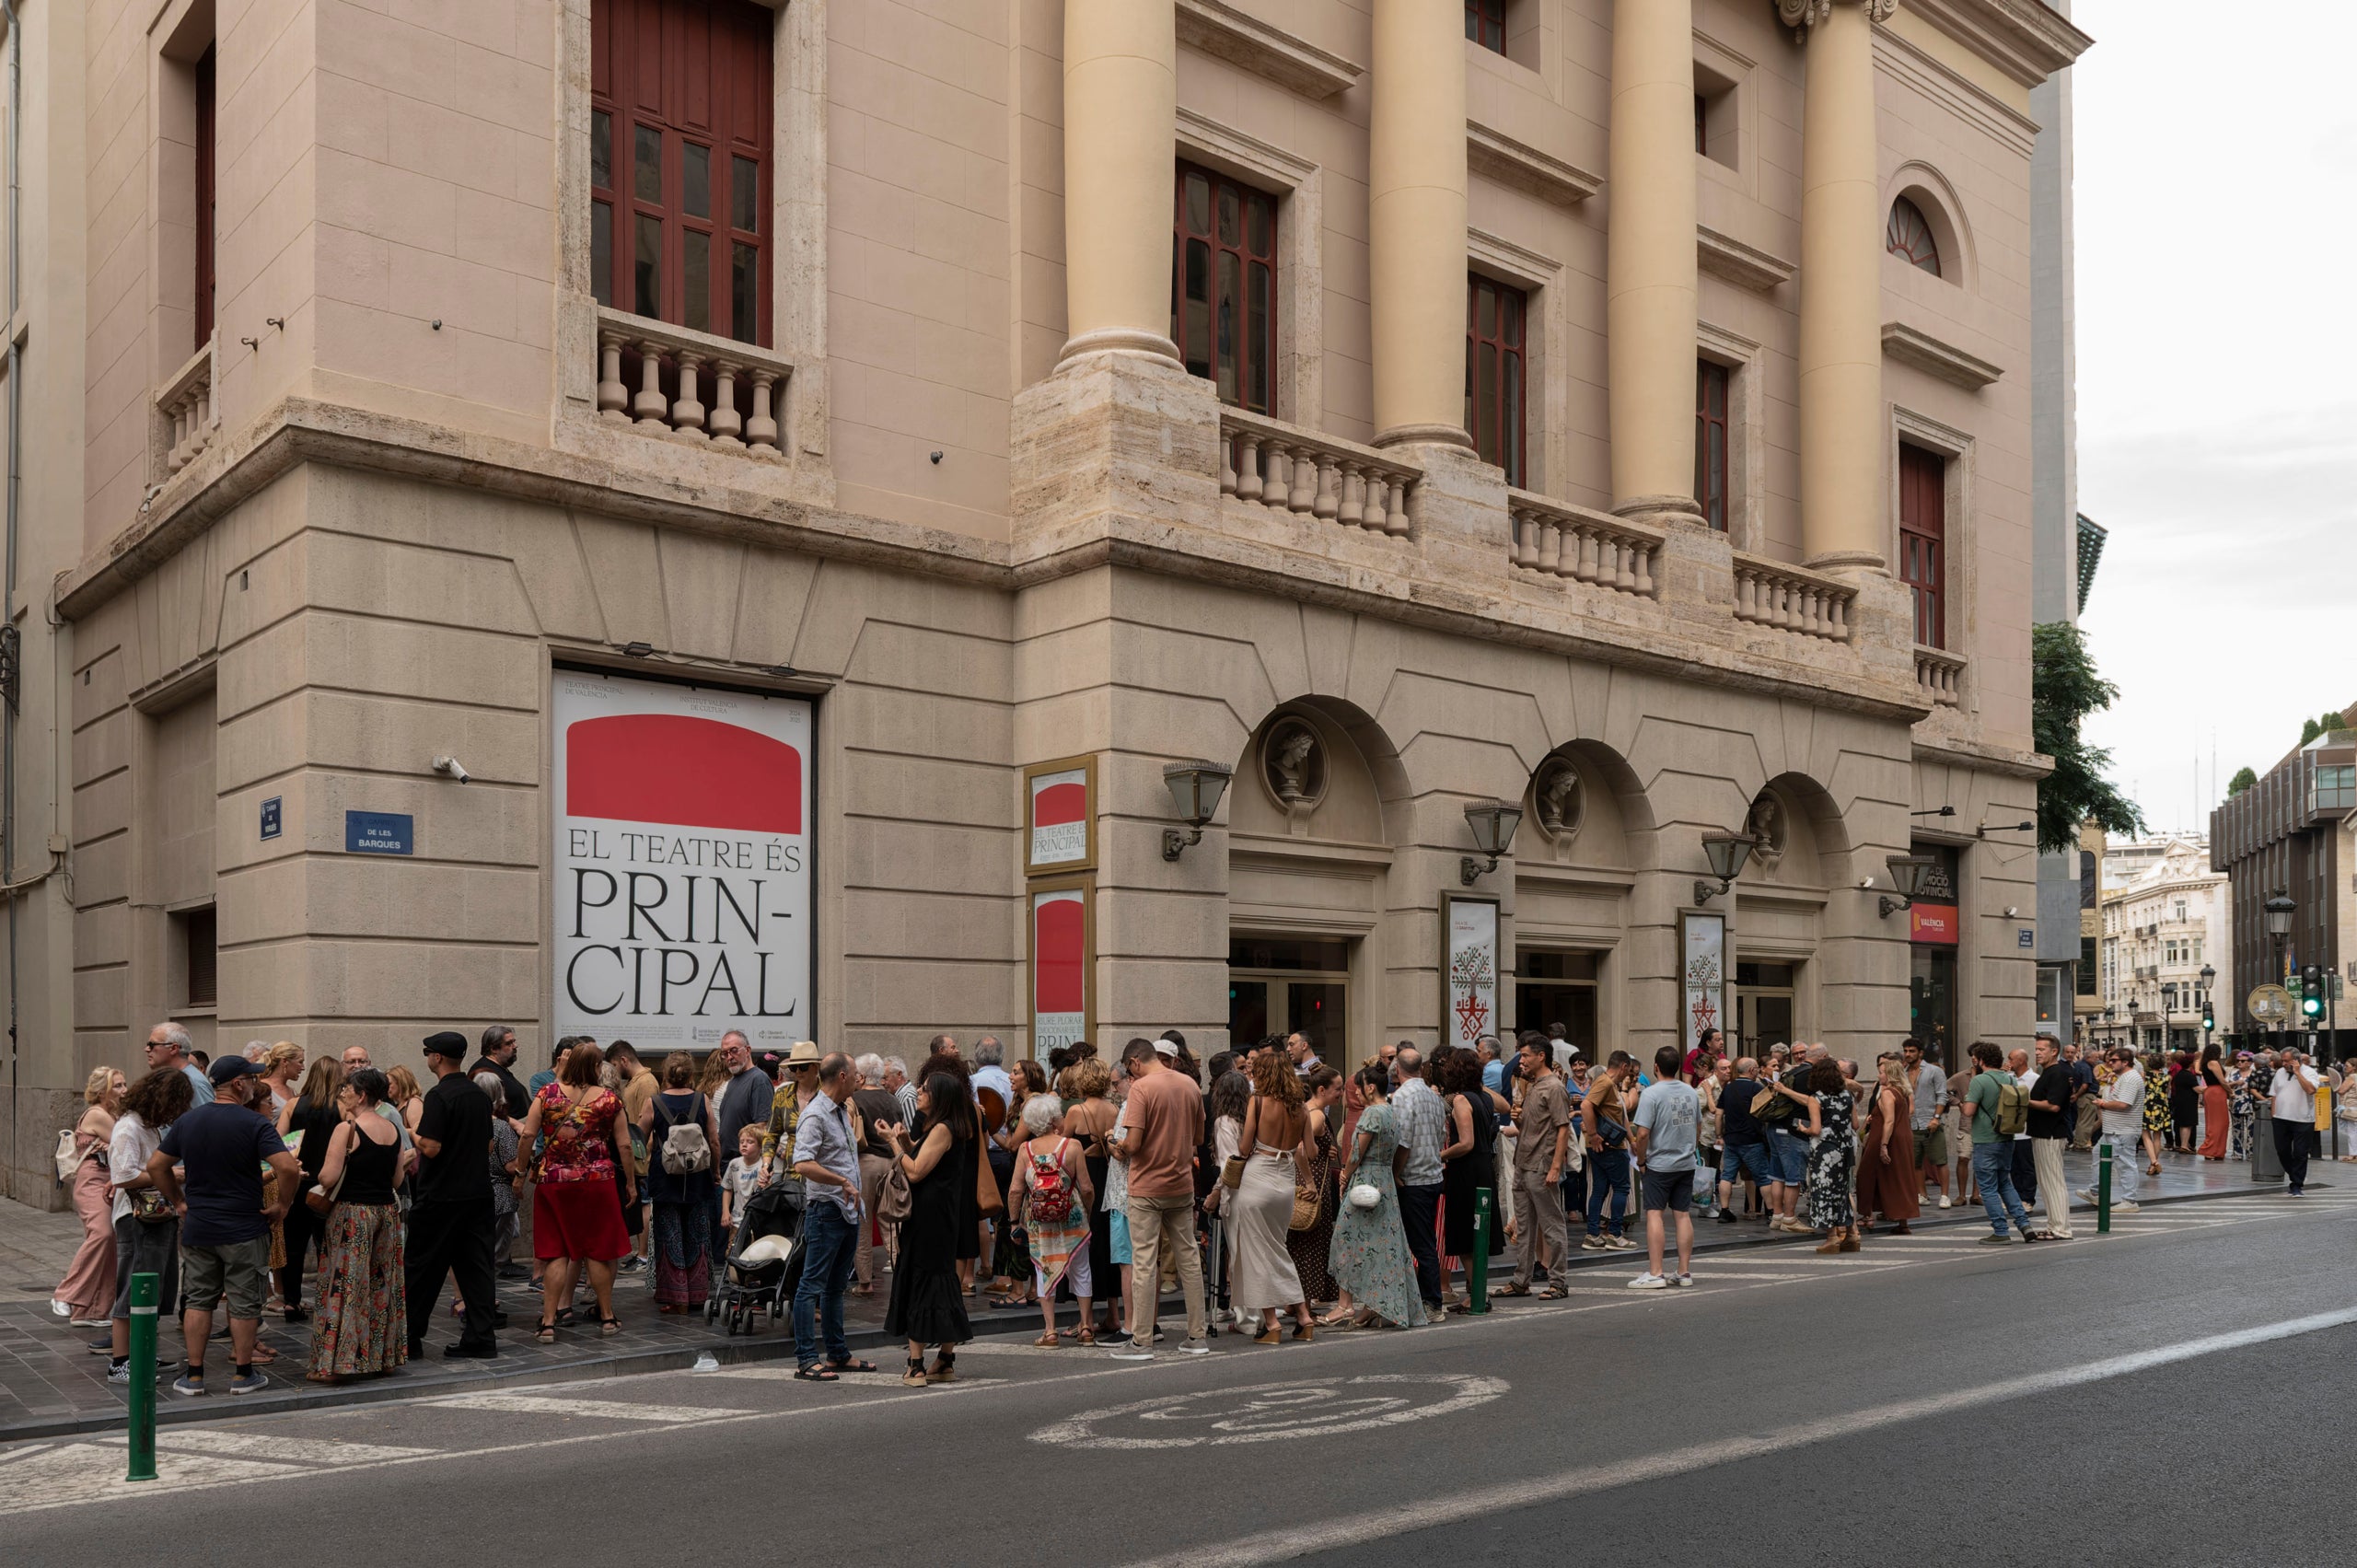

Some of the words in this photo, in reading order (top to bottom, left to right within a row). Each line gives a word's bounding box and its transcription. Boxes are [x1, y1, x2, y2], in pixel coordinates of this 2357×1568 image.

[358, 839, 401, 849] BARQUES
[1034, 835, 1086, 854] PRINCIPAL
[1047, 824, 1077, 838] TEATRE
[568, 829, 611, 860] EL
[621, 832, 753, 870] TEATRE
[765, 838, 802, 873] ÉS
[567, 867, 792, 947] PRIN-
[566, 944, 796, 1016] CIPAL
